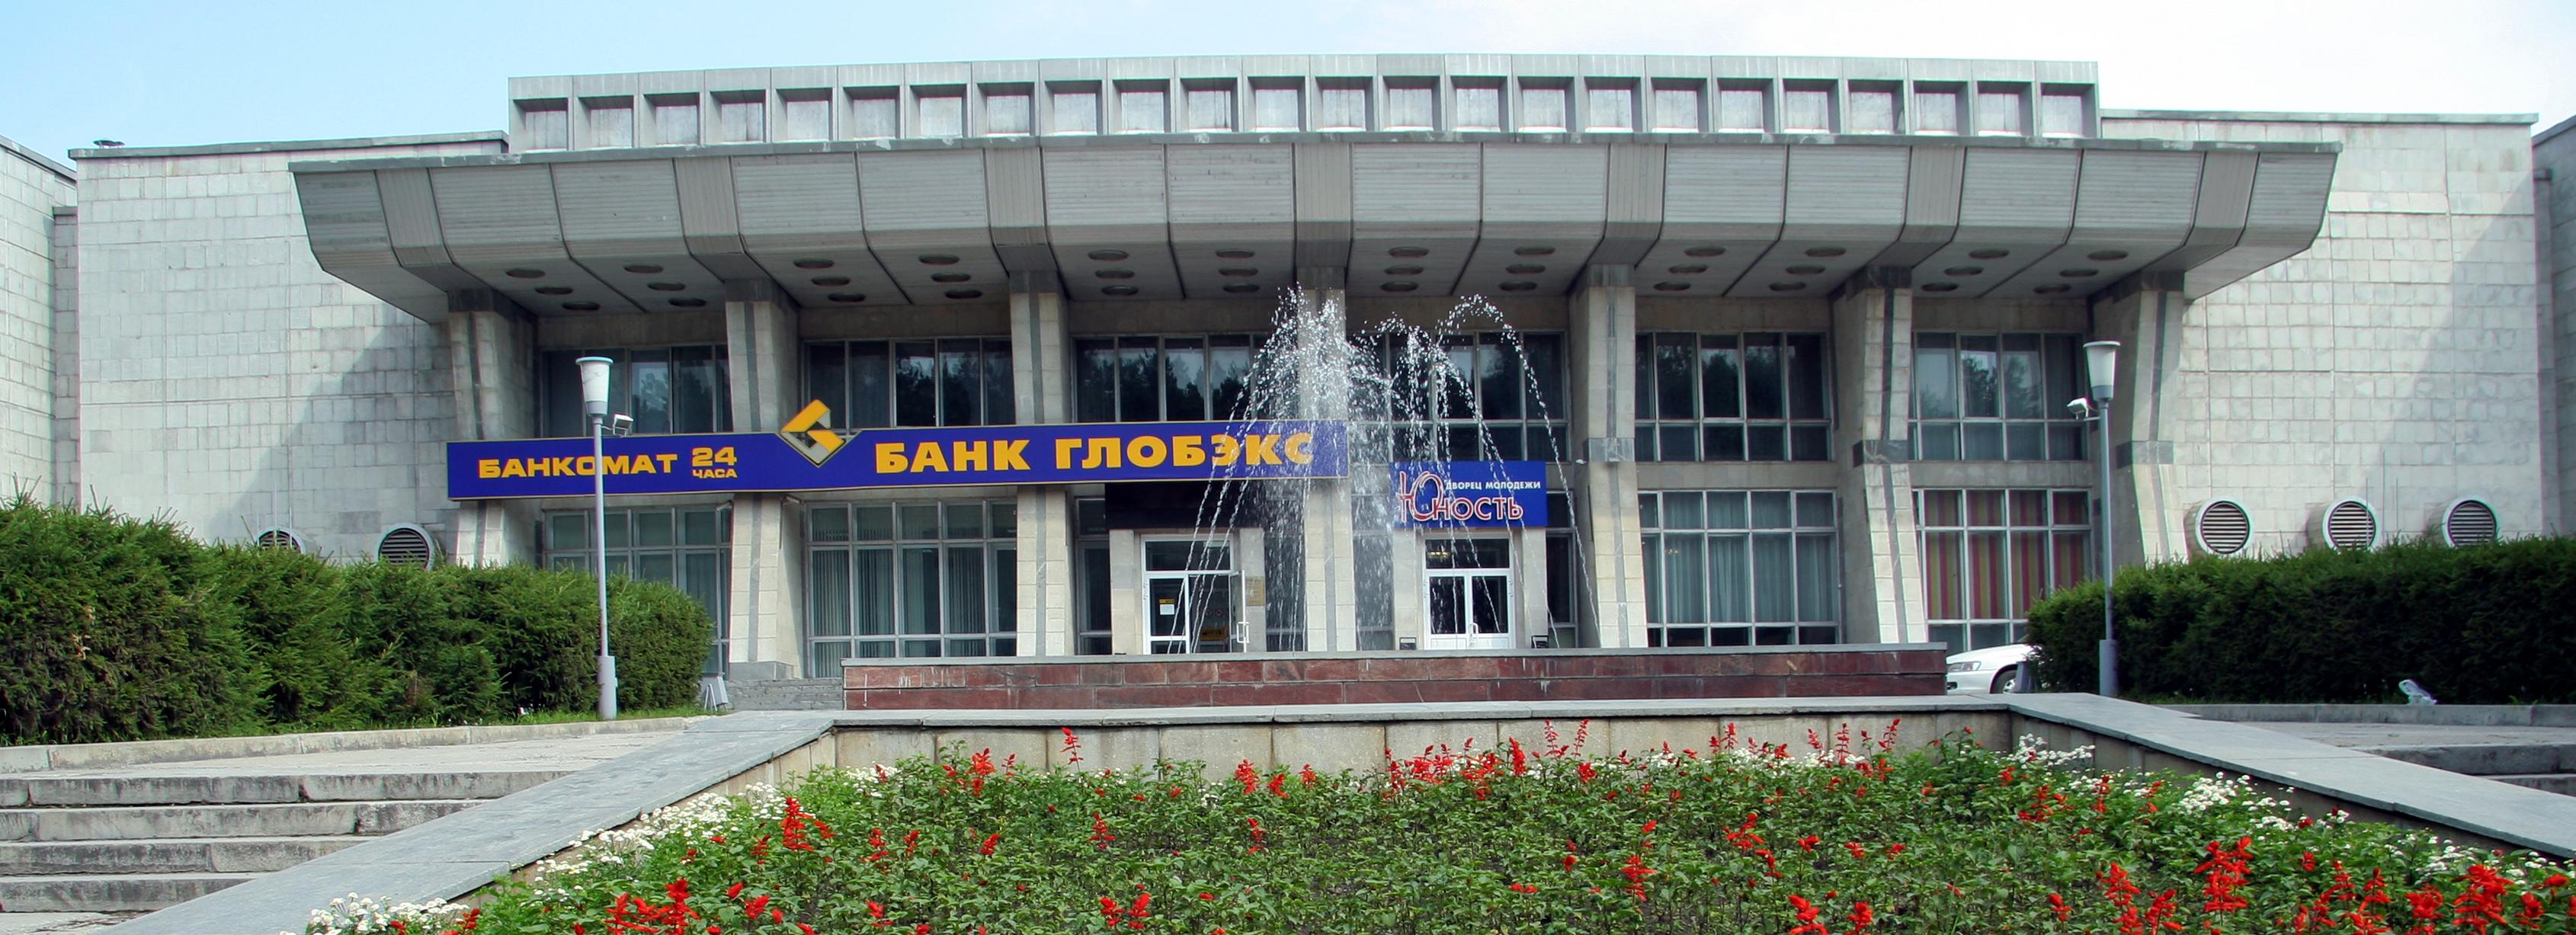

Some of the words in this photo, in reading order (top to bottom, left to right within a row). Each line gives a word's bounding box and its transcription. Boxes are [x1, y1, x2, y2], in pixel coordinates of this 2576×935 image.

[479, 454, 678, 479] БАНКОМАТ
[692, 447, 737, 466] 24
[876, 440, 1030, 473] БАНК
[1056, 433, 1314, 469] ГЛОБЭКС
[693, 469, 738, 479] ЧАСА
[1446, 482, 1482, 490] ДВОРЕЦ
[1485, 481, 1541, 489] МОЛОДЕЖИ
